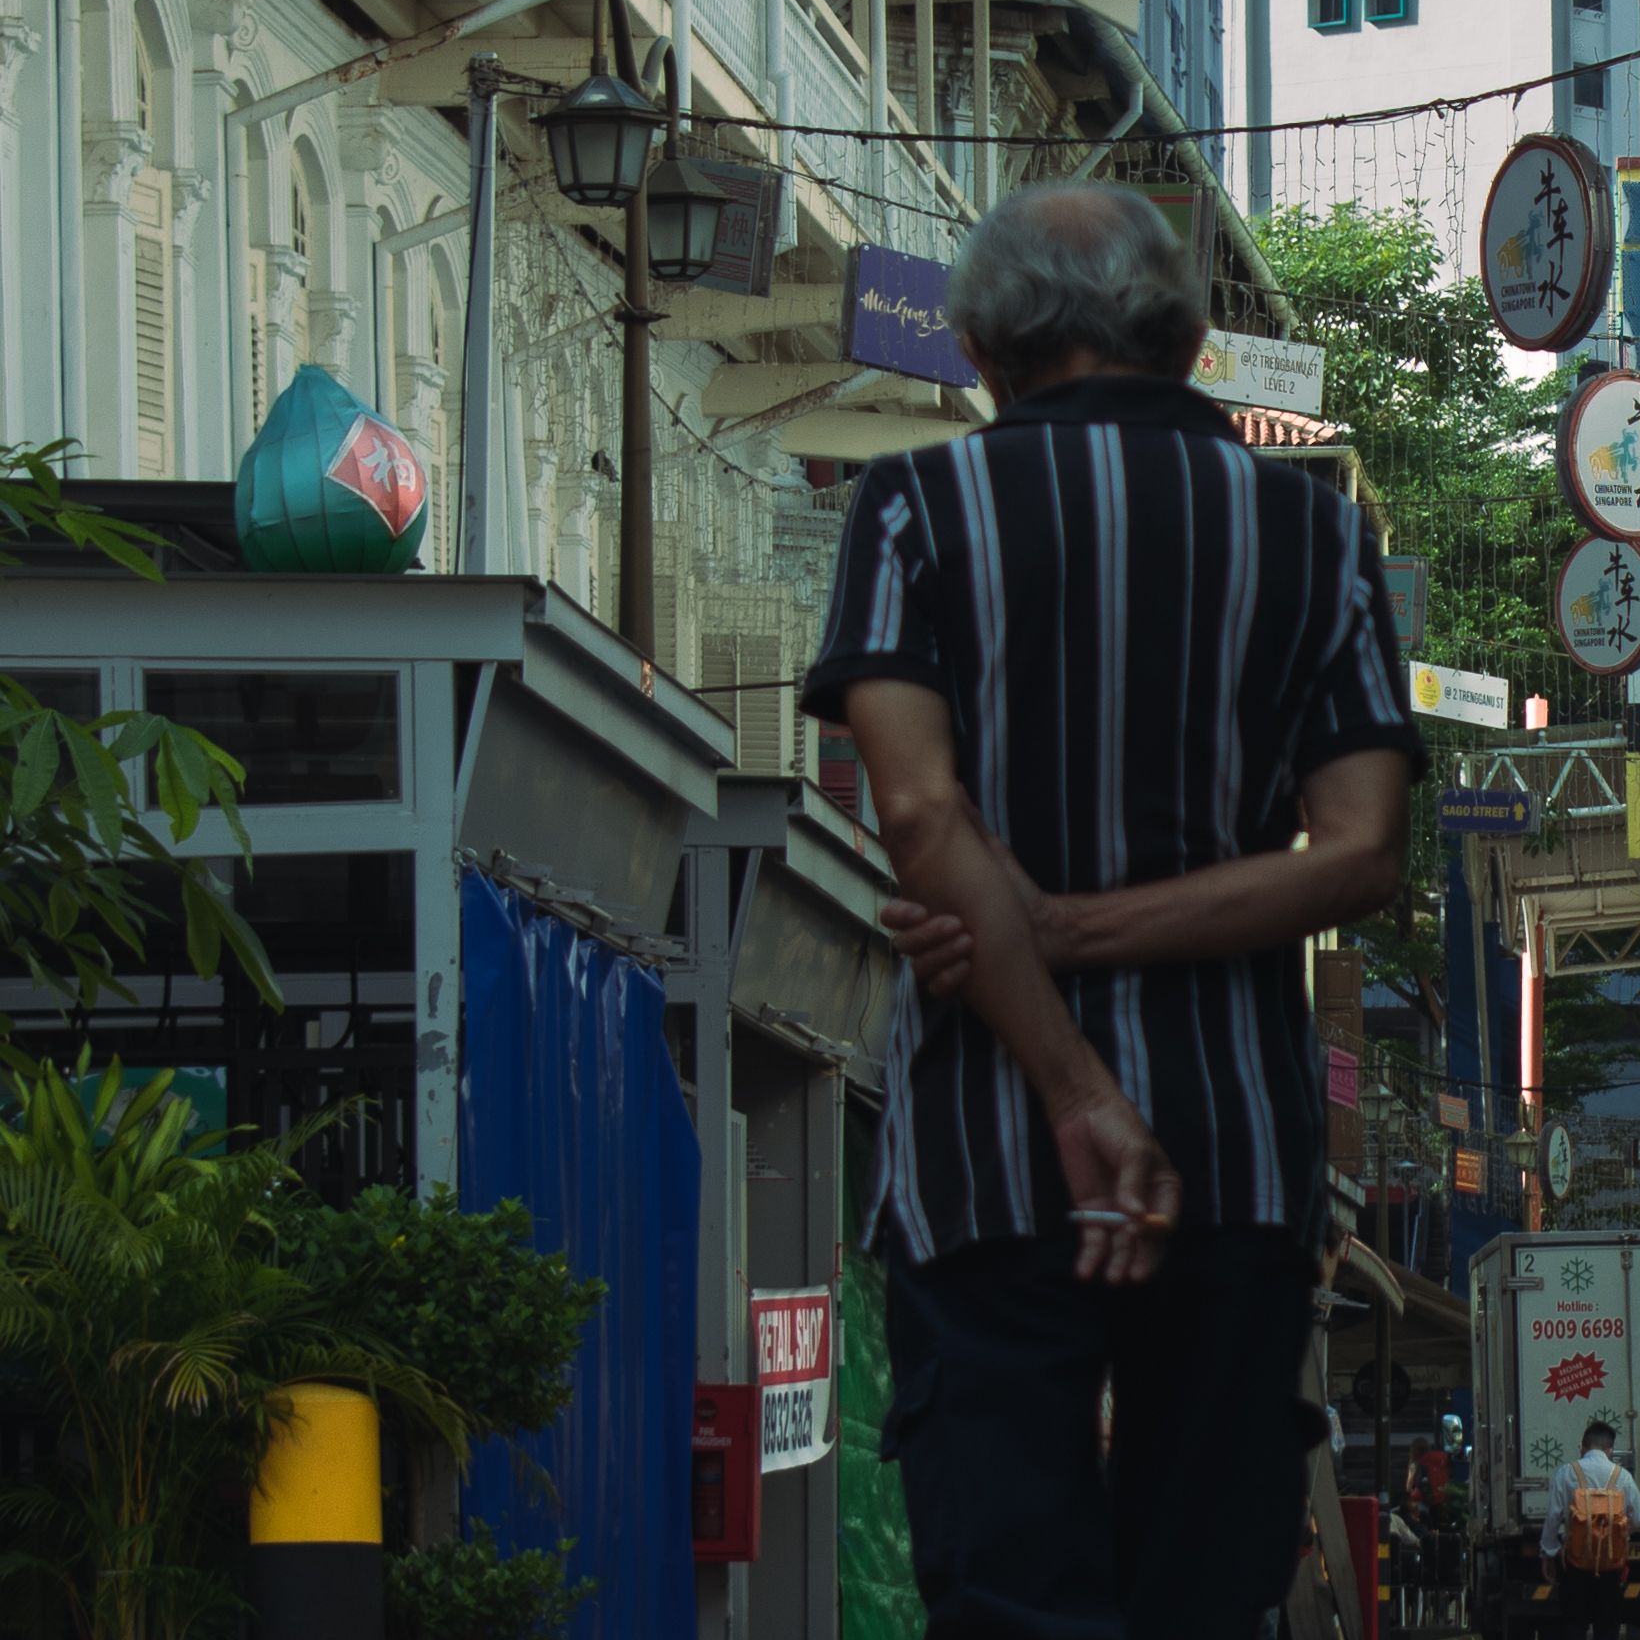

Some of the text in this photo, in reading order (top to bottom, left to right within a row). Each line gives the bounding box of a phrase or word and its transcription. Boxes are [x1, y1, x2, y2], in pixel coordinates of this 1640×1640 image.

[1534, 158, 1574, 318] 牛车水
[1502, 281, 1536, 298] CHINATOWN
[1502, 297, 1536, 313] SINGAPORE
[1264, 377, 1295, 395] LEVEL 2
[1594, 484, 1632, 494] CHINATOWN
[1594, 496, 1632, 507] SINGAPORE
[1603, 544, 1640, 654] 牛车水
[1459, 689, 1495, 708] TRENGGANU
[1496, 696, 1504, 709] ST
[1442, 805, 1509, 818] SAGO STREET
[1524, 1254, 1534, 1273] 2
[1557, 1300, 1593, 1312] Hotline
[1532, 1318, 1624, 1340] 9009 6698
[758, 1310, 794, 1374] RETAIL
[1556, 1368, 1592, 1387] DELIVERY
[1558, 1361, 1583, 1375] HOME
[1559, 1375, 1598, 1395] AVAILABLE
[764, 1391, 790, 1455] 8932
